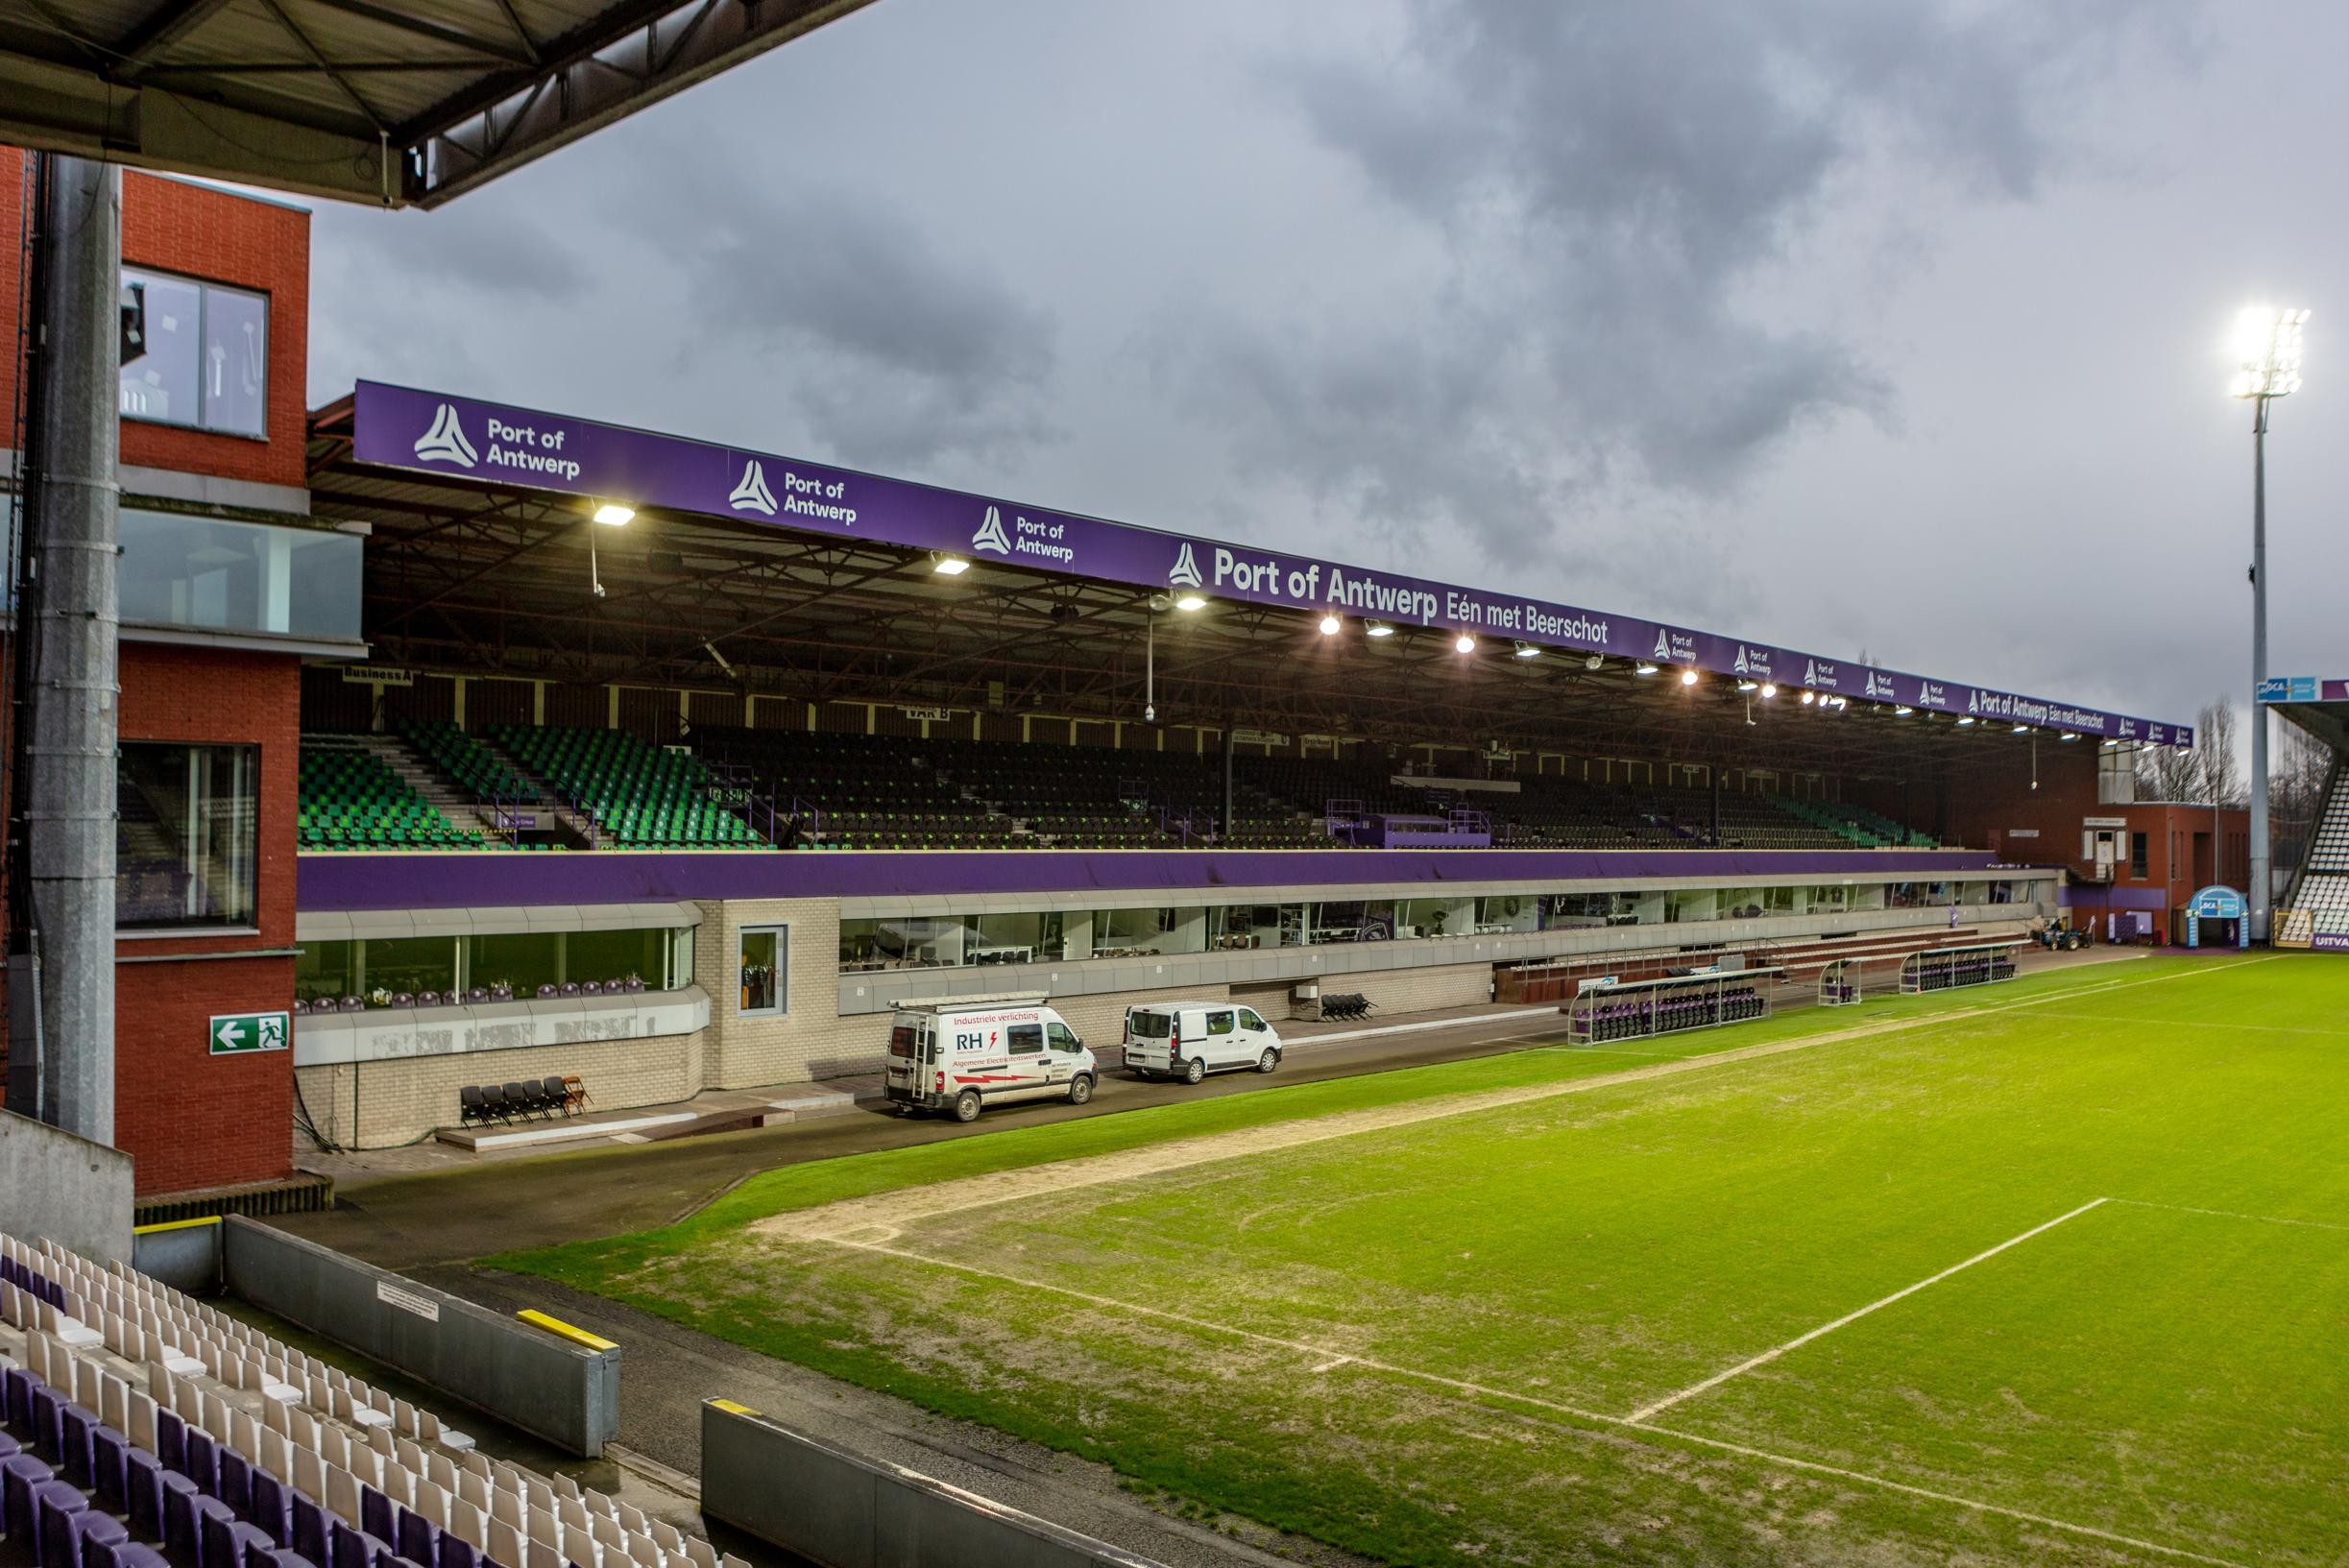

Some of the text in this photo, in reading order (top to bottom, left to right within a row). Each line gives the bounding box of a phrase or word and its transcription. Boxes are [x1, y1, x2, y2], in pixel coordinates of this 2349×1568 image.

[488, 419, 565, 450] Port of
[486, 444, 580, 480] Antwerp
[785, 472, 845, 499] Port of
[784, 494, 857, 526] Antwerp
[1016, 516, 1064, 540] Port of
[1015, 537, 1074, 564] Antwerp
[1215, 548, 1608, 644] Port of Antwerp Eén met Beerschot
[1672, 634, 1693, 648] Port of
[1671, 646, 1697, 663] Antwerp
[1750, 649, 1768, 663] Port of
[345, 666, 411, 682] Business A
[1750, 661, 1772, 676] Antwerp
[1980, 690, 2000, 713] Port
[2001, 695, 2012, 714] of
[2013, 696, 2047, 725] Antwerp
[2062, 708, 2074, 724] met
[2075, 709, 2104, 730] Beerschot
[954, 1012, 1039, 1026] Industriele verlichting
[957, 1032, 982, 1050] RH
[953, 1059, 985, 1069] Algemene
